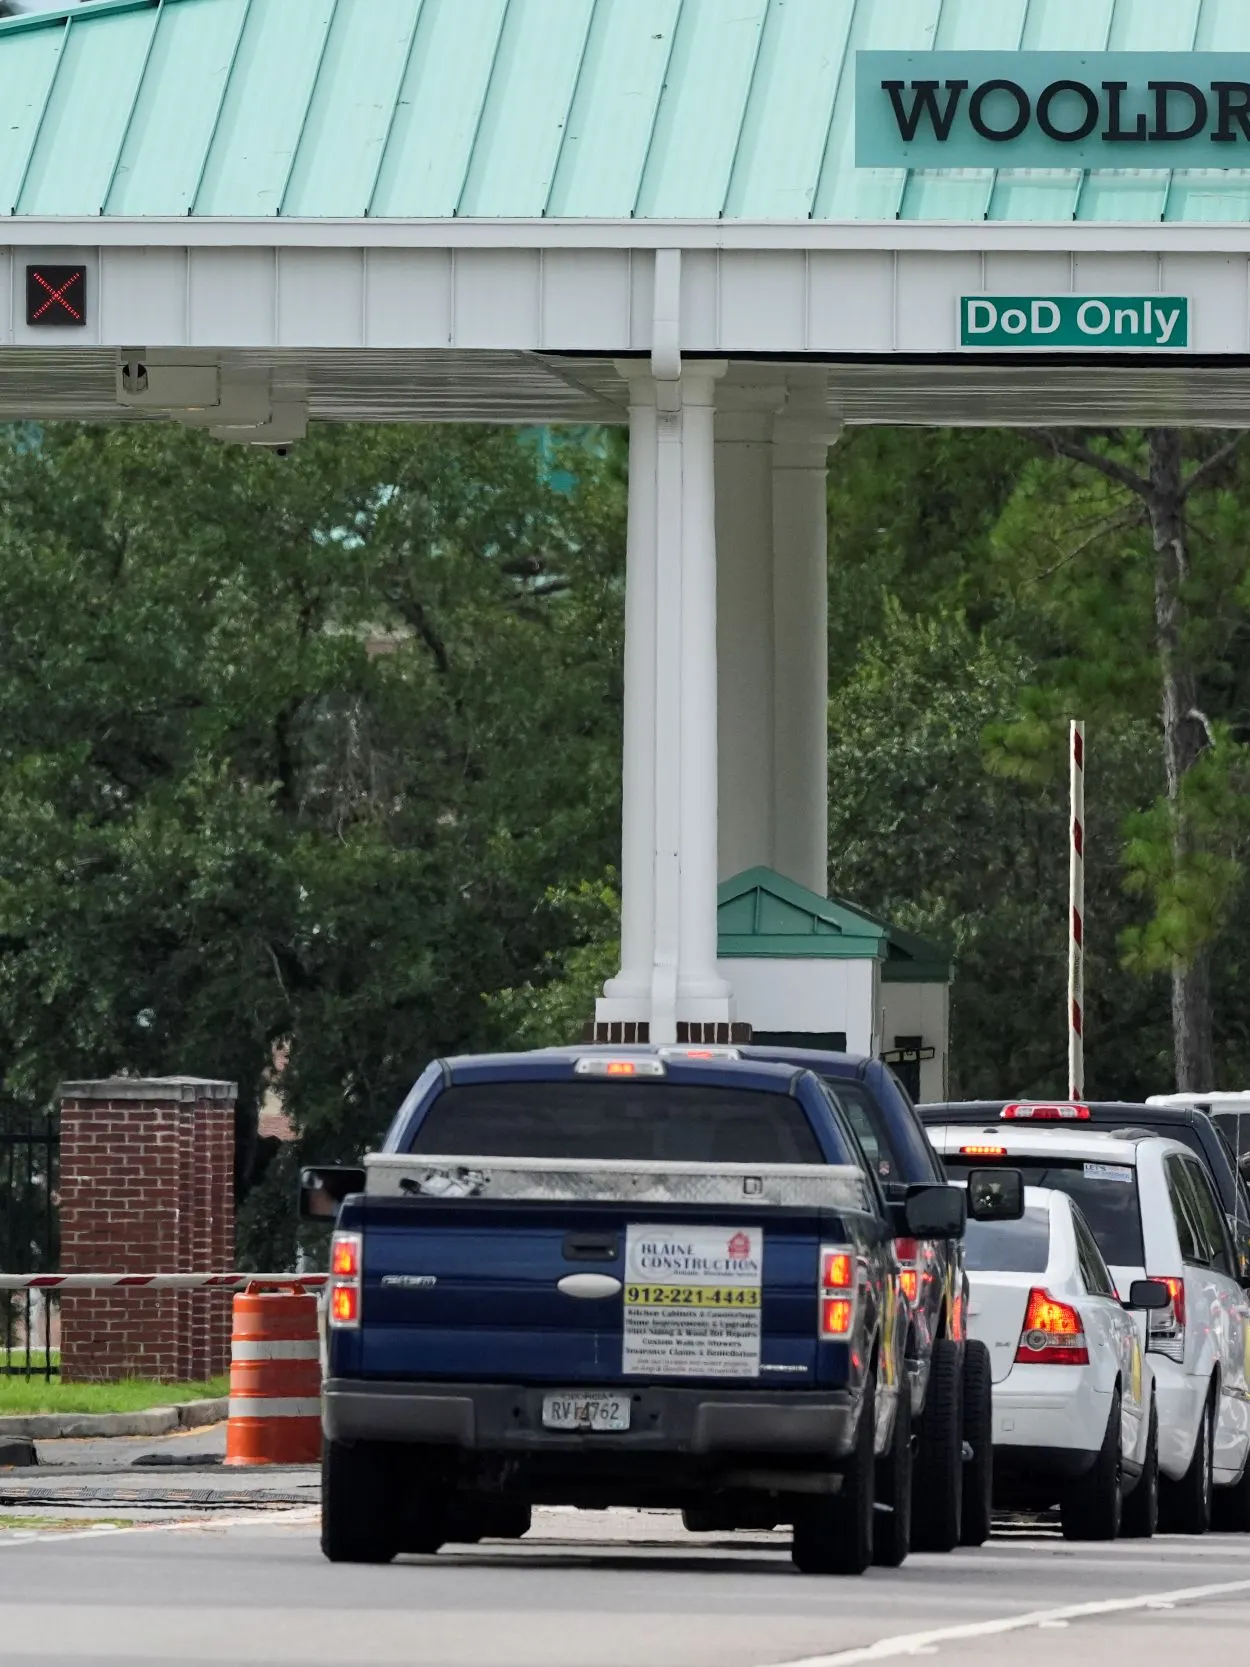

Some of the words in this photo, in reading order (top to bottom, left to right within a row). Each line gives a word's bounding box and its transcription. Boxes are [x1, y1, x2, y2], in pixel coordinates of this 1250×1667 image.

[967, 300, 1061, 335] DoD
[1076, 300, 1180, 344] Only
[641, 1243, 695, 1255] BLAINE
[641, 1256, 758, 1270] CONSTRUCTION
[628, 1286, 758, 1304] 912-221-4443
